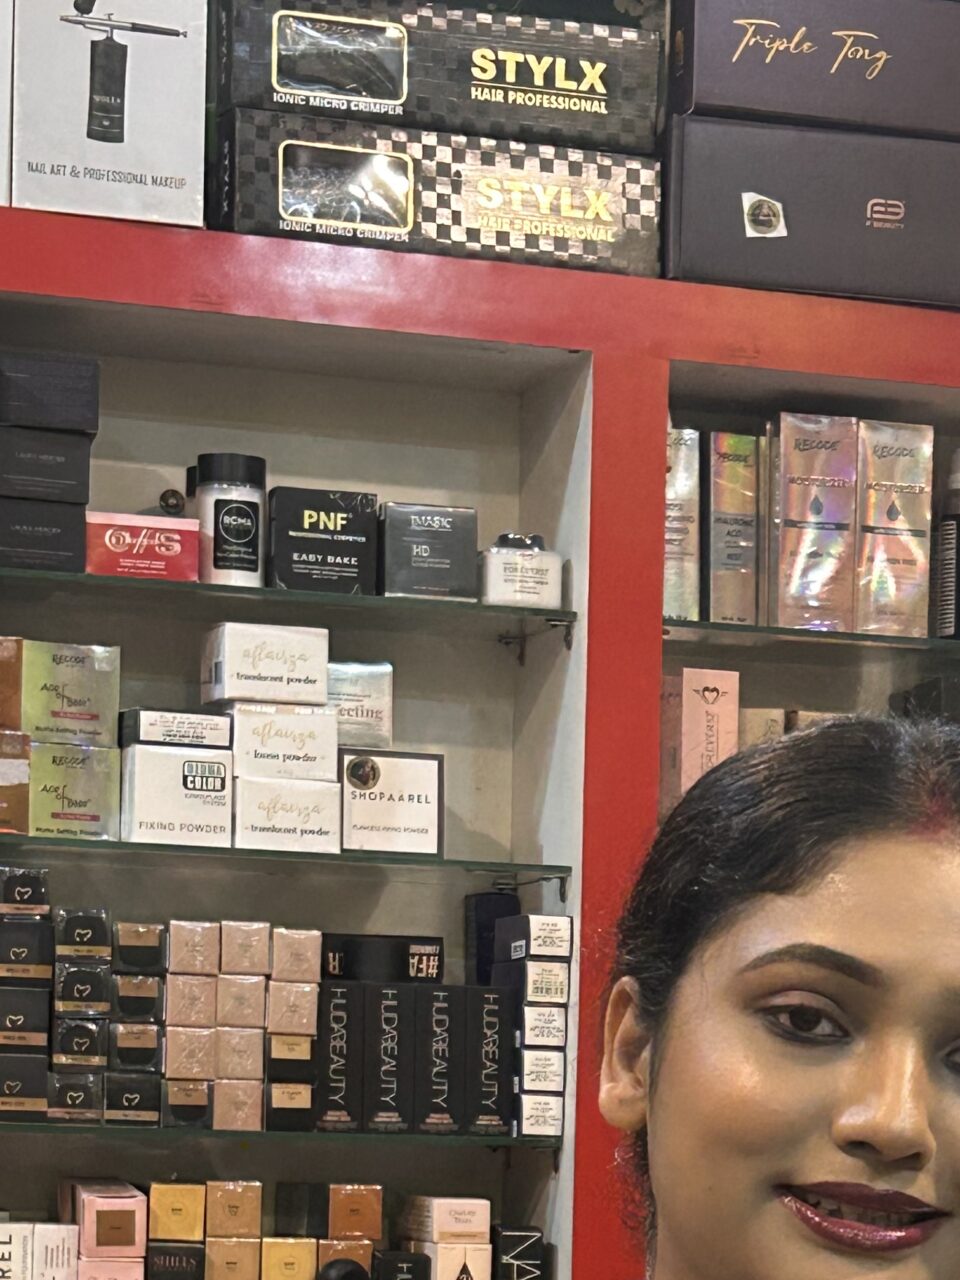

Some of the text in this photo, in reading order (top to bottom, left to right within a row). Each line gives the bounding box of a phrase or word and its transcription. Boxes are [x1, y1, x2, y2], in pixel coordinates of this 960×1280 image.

[732, 18, 818, 64] Triple
[471, 47, 607, 94] STYLX
[273, 92, 404, 115] IONIC MICRO CRIMPER
[471, 87, 609, 115] HAIR PROFESSIONAL
[27, 161, 187, 190] NAIL ART & PROFESSIONAL MAKEUP
[476, 177, 614, 222] STYLX
[279, 220, 409, 243] IONIC MICRO CRIMPER
[478, 215, 616, 242] HAIR PROFESSIONAL
[793, 438, 841, 452] RECODE
[872, 444, 915, 460] RECODE
[303, 509, 348, 531] PNF
[412, 545, 430, 557] HD
[187, 776, 222, 790] COLOR
[351, 790, 431, 804] SHOPAAREL
[138, 820, 227, 835] FIXING POWDER
